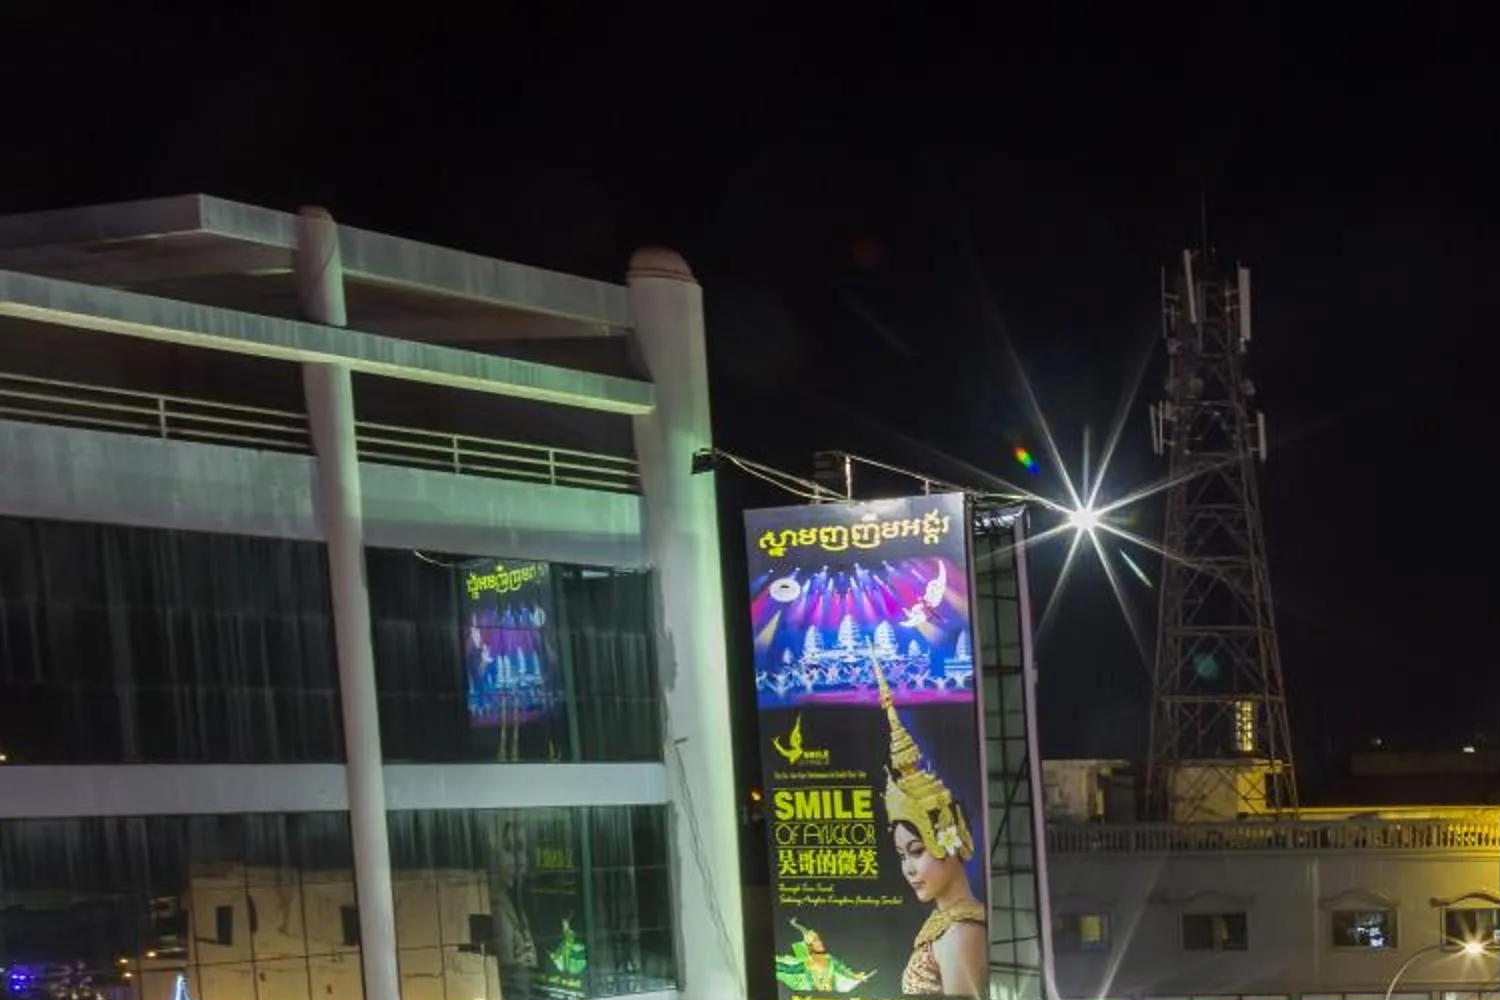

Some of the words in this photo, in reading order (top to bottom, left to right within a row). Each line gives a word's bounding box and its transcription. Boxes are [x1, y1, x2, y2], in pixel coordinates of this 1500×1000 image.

[774, 789, 874, 820] SMILE
[775, 823, 800, 845] OF
[803, 822, 876, 845] ANGKOR
